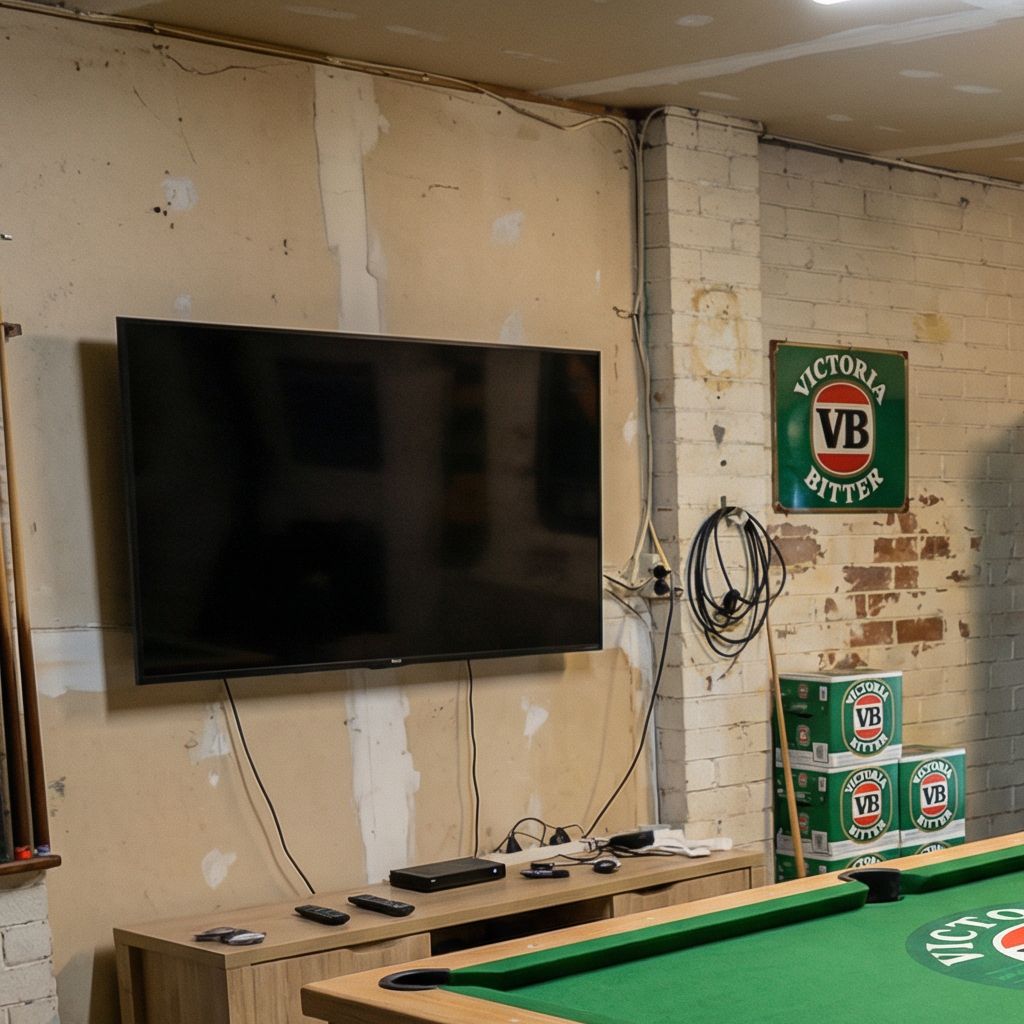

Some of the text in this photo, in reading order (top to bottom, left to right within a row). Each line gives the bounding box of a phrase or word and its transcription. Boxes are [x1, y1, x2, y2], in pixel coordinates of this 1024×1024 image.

[793, 354, 886, 406] VICTORIA
[815, 408, 870, 449] VB
[804, 465, 884, 504] BITTER
[855, 706, 882, 728] VB
[854, 793, 880, 815] VB
[922, 784, 947, 805] VB
